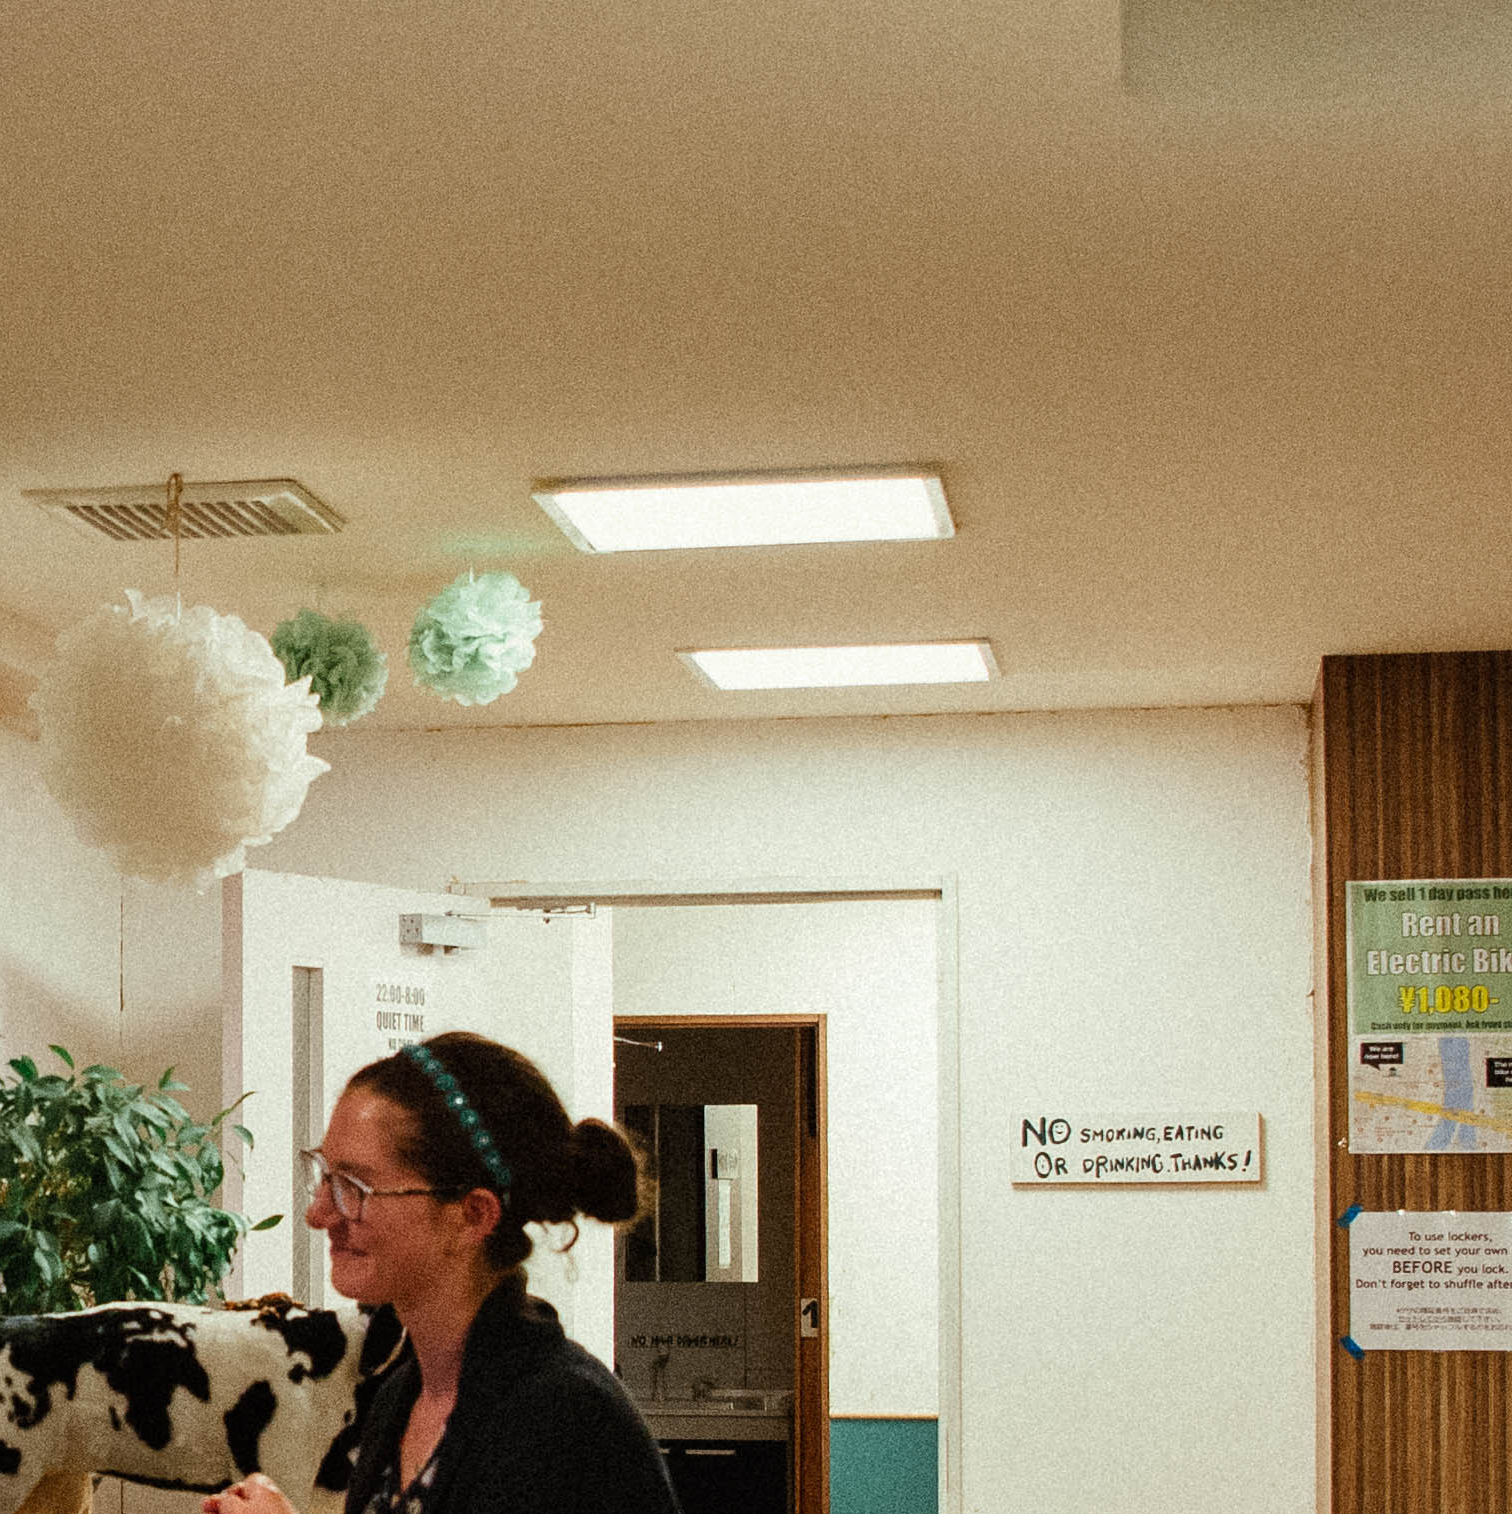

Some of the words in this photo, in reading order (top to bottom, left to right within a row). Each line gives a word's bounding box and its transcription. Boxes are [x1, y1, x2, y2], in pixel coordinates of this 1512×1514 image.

[1364, 889, 1386, 902] We
[1390, 888, 1415, 901] sell
[1419, 888, 1425, 900] 1
[1428, 887, 1454, 902] day
[1457, 888, 1490, 902] pass
[1401, 912, 1462, 937] Rent
[1467, 915, 1500, 936] an
[1367, 949, 1465, 975] Electric
[376, 1010, 401, 1031] QUIET
[404, 1013, 424, 1032] TIME
[1022, 1117, 1071, 1147] NO
[1034, 1151, 1068, 1178] OR
[1409, 1231, 1421, 1241] To
[1425, 1233, 1443, 1241] use
[1448, 1231, 1493, 1242] lockers,
[1362, 1248, 1383, 1257] you
[1387, 1246, 1415, 1255] need
[1419, 1247, 1431, 1255] to
[1434, 1247, 1451, 1255] set
[1455, 1247, 1480, 1257] your
[1484, 1247, 1508, 1255] own
[1392, 1261, 1453, 1274] BEFORE
[1457, 1265, 1478, 1276] you
[1355, 1279, 1387, 1289] Don't
[1390, 1279, 1425, 1291] forget
[1429, 1280, 1441, 1289] to
[1444, 1279, 1483, 1289] shuffle
[802, 1300, 818, 1328] 1
